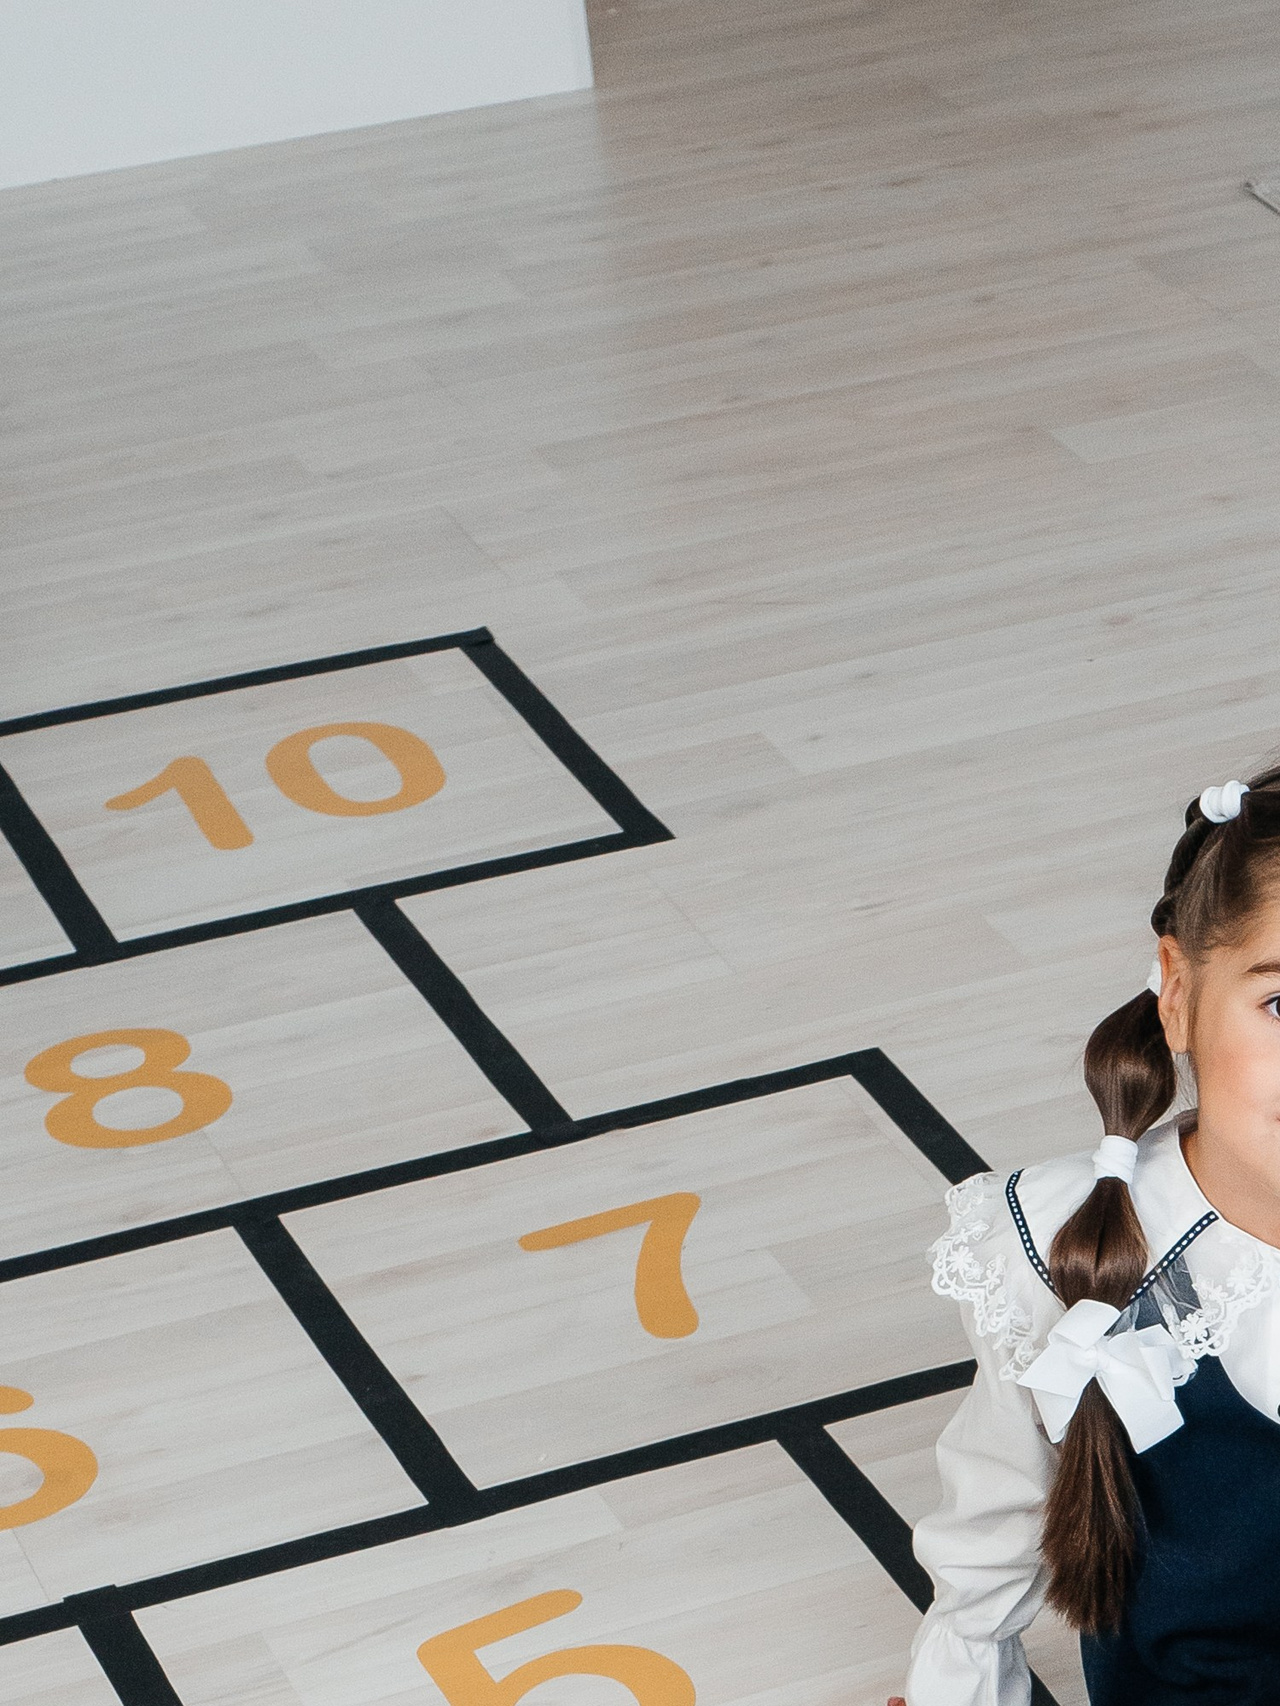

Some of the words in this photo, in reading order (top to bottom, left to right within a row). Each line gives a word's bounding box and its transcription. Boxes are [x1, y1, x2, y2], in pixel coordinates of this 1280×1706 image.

[104, 722, 446, 850] 10
[24, 1028, 234, 1149] 8
[518, 1192, 701, 1339] 7
